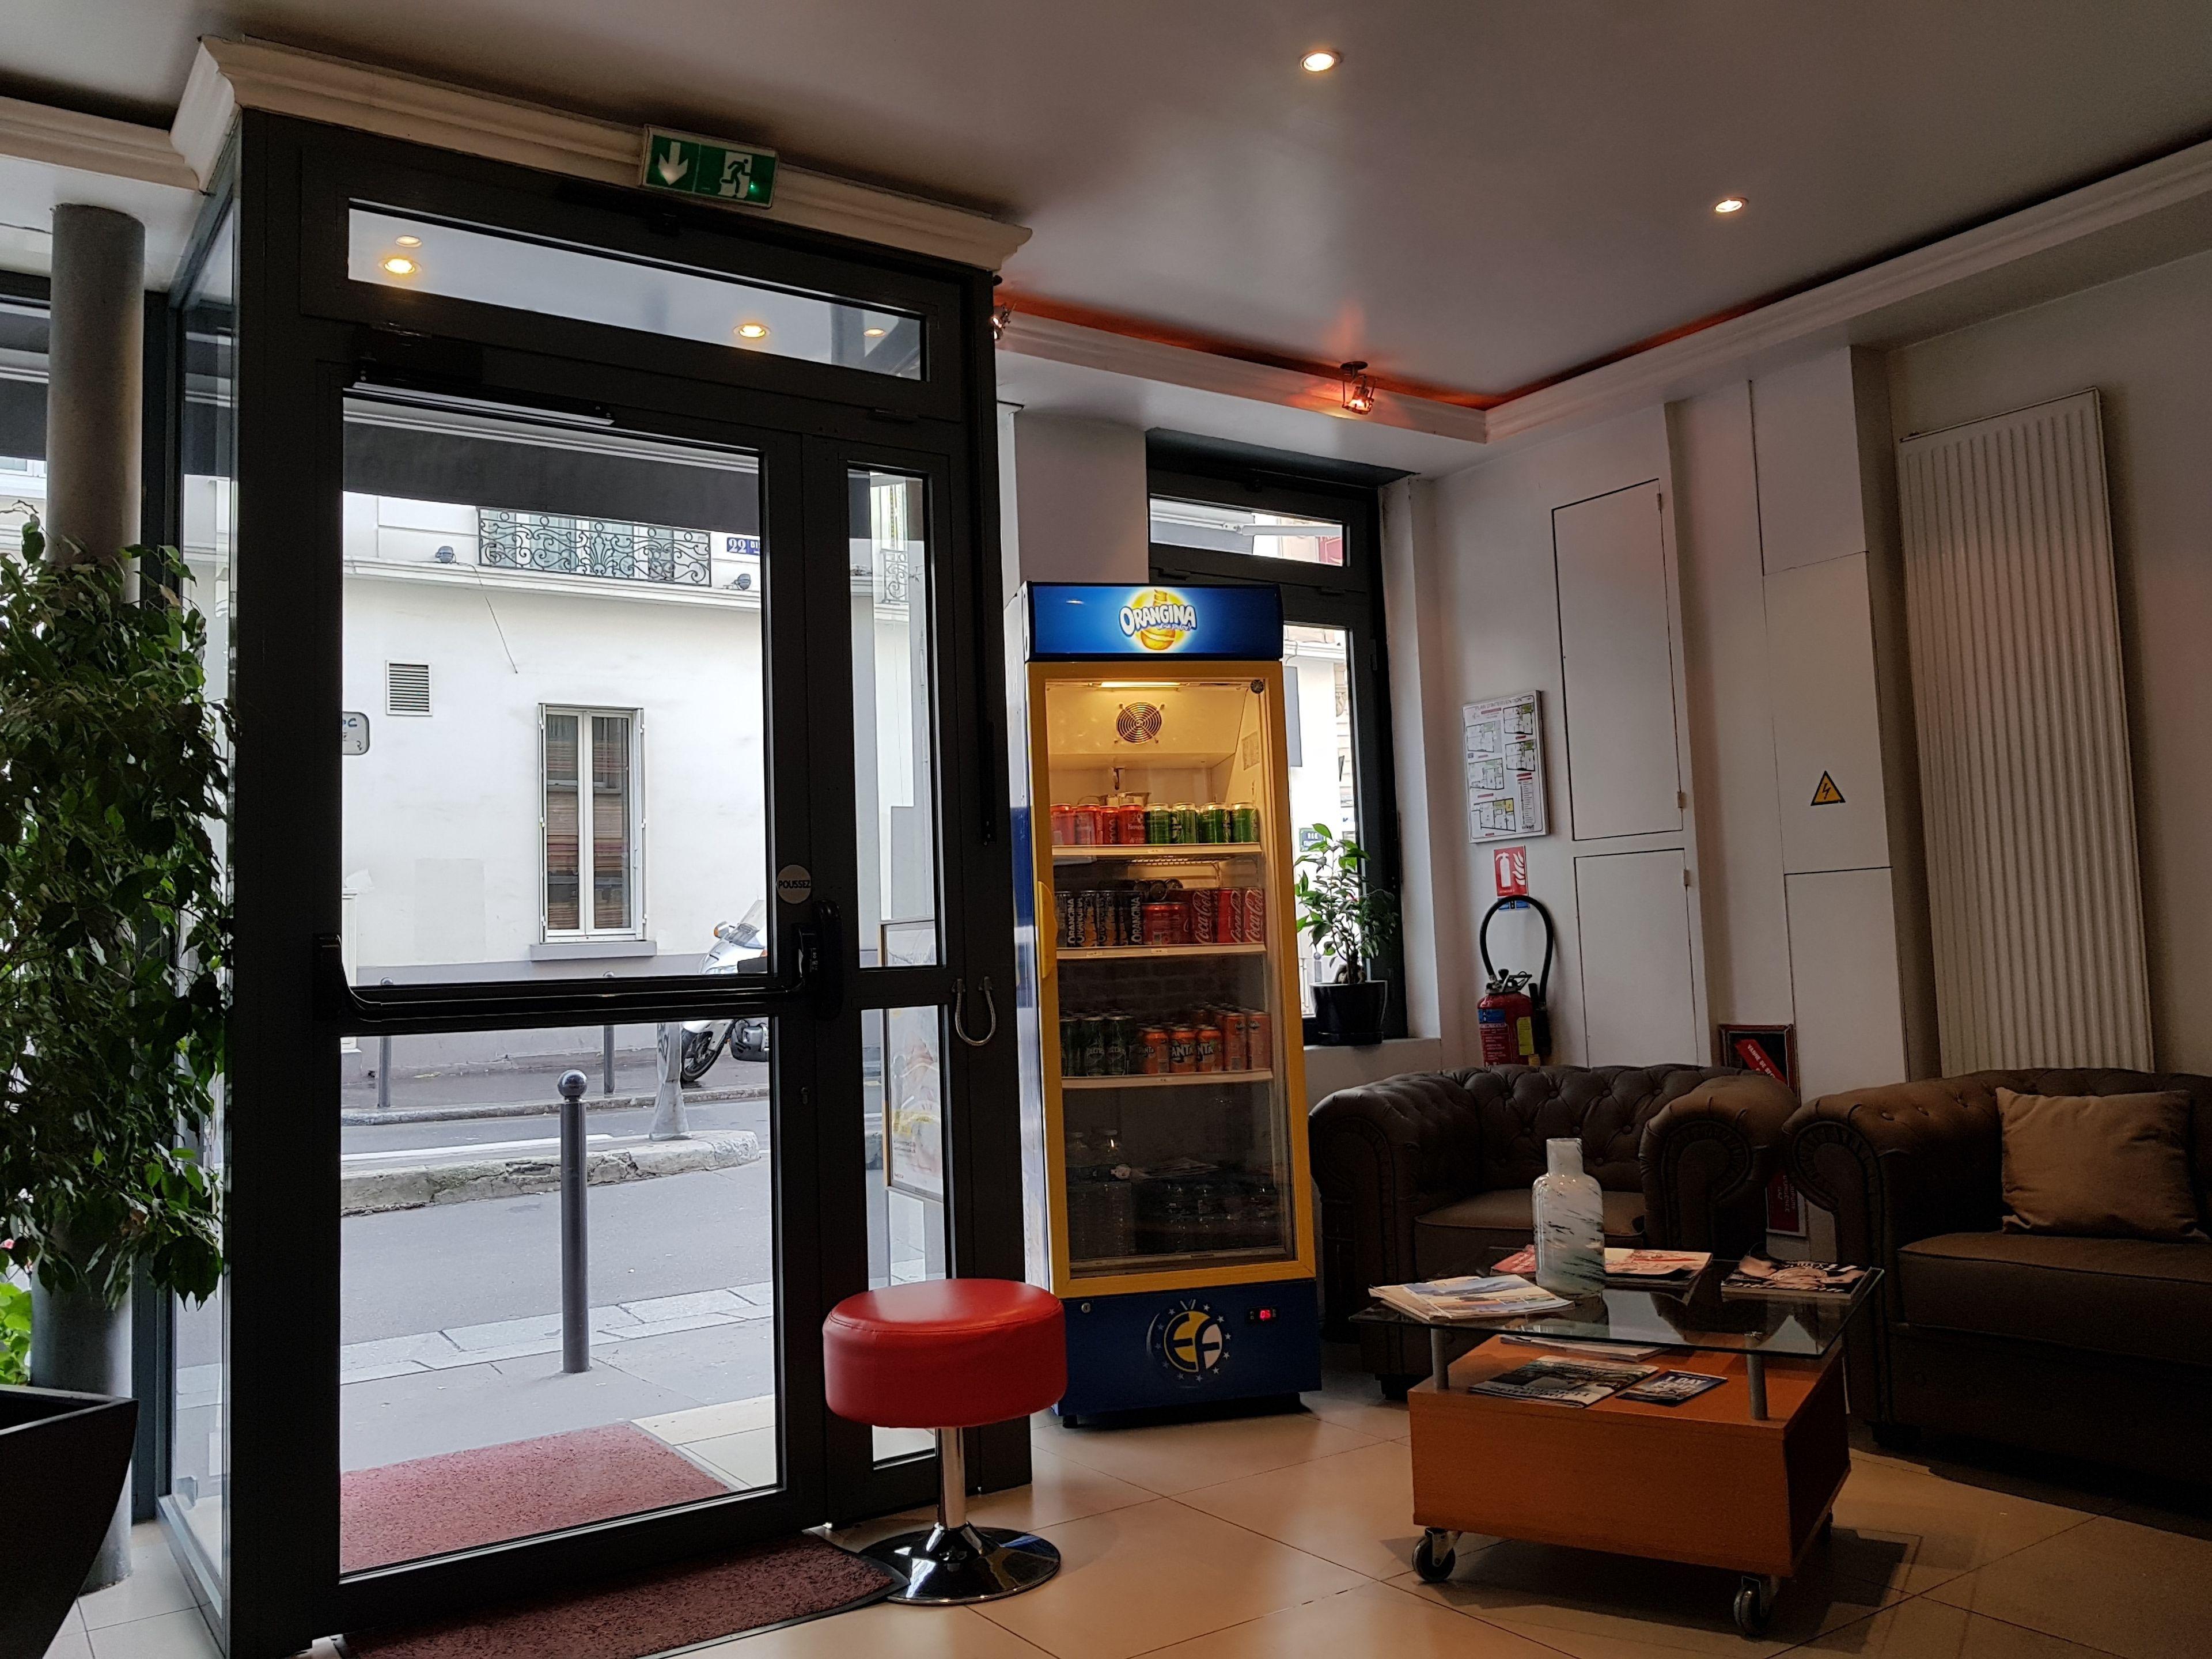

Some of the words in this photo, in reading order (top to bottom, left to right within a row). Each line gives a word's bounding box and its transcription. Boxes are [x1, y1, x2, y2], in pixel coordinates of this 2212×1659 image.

[728, 538, 747, 554] 22
[1119, 604, 1197, 637] ORANGINA
[778, 880, 812, 889] POUSSEZ
[1130, 896, 1142, 944] ORANGINA
